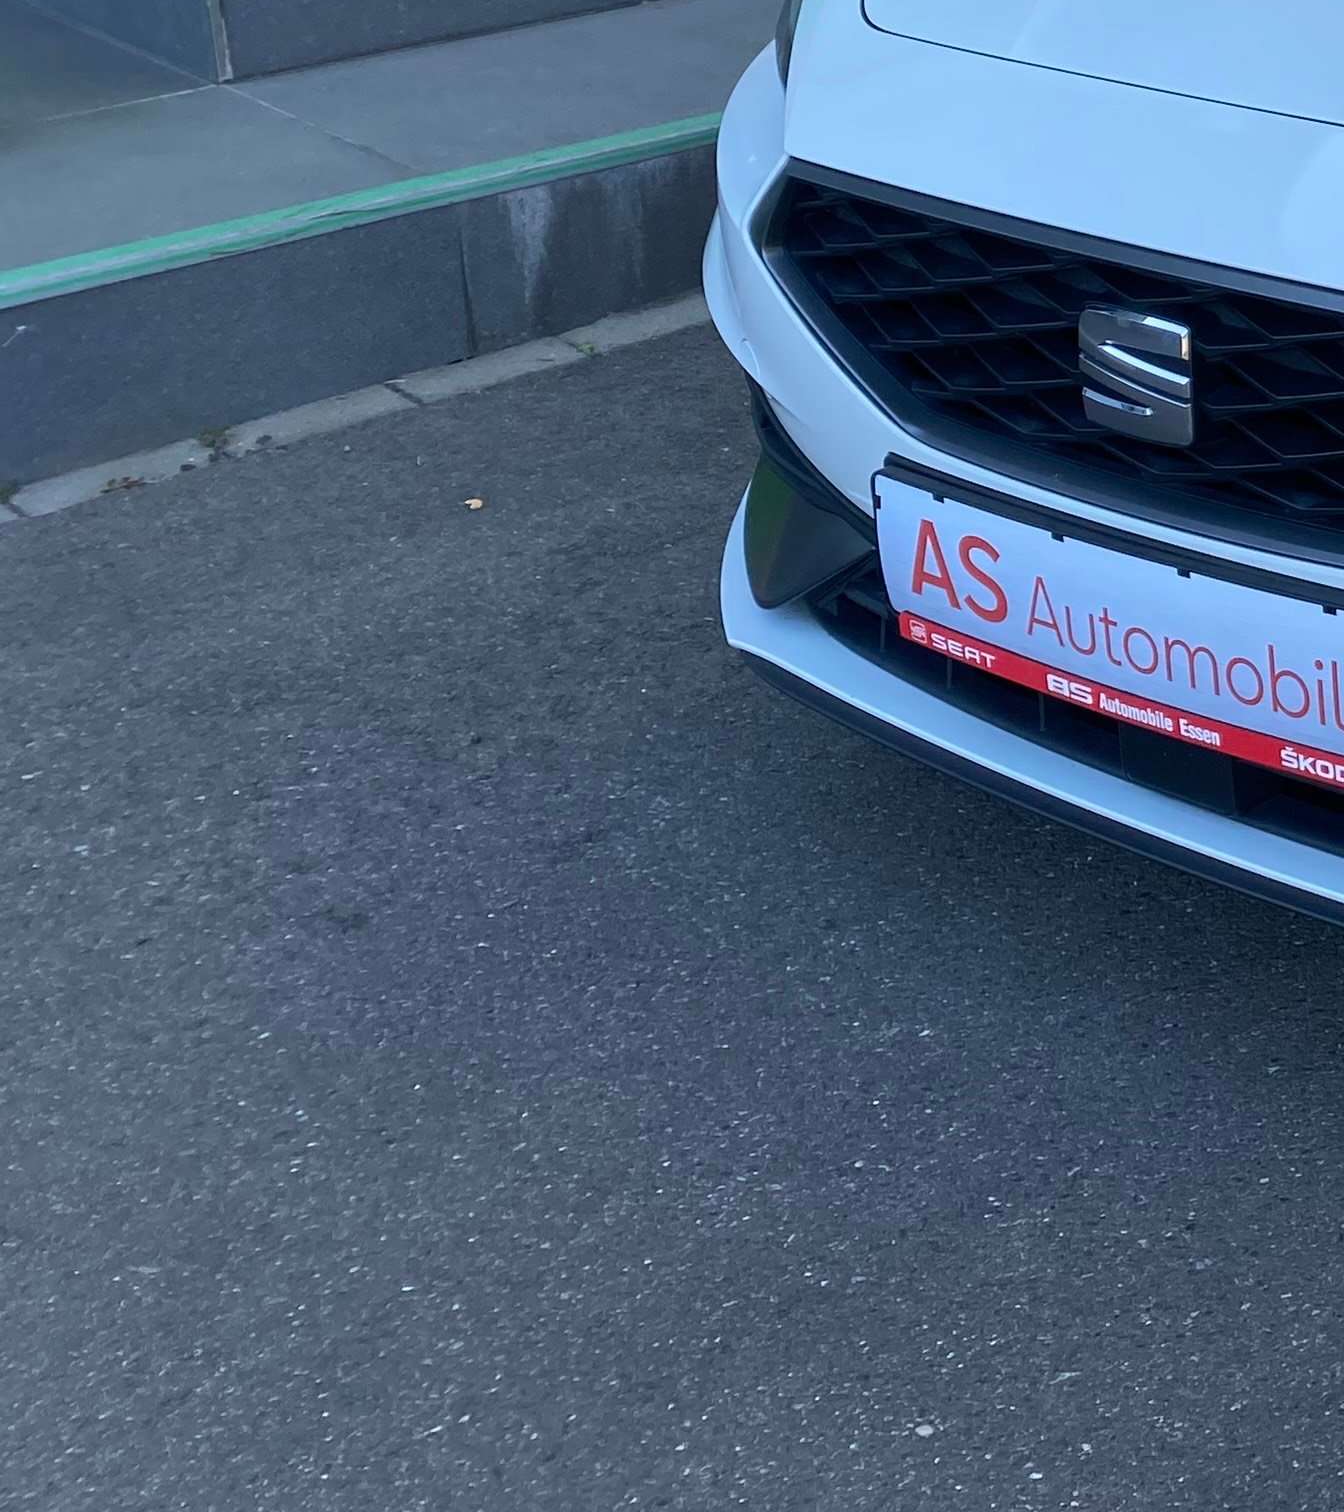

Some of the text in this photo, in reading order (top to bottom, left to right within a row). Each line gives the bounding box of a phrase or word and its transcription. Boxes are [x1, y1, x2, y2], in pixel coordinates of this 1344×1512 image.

[911, 518, 1009, 624] AS
[930, 632, 997, 669] SEAT
[1099, 692, 1174, 733] Automobile
[1178, 717, 1221, 747] Essen
